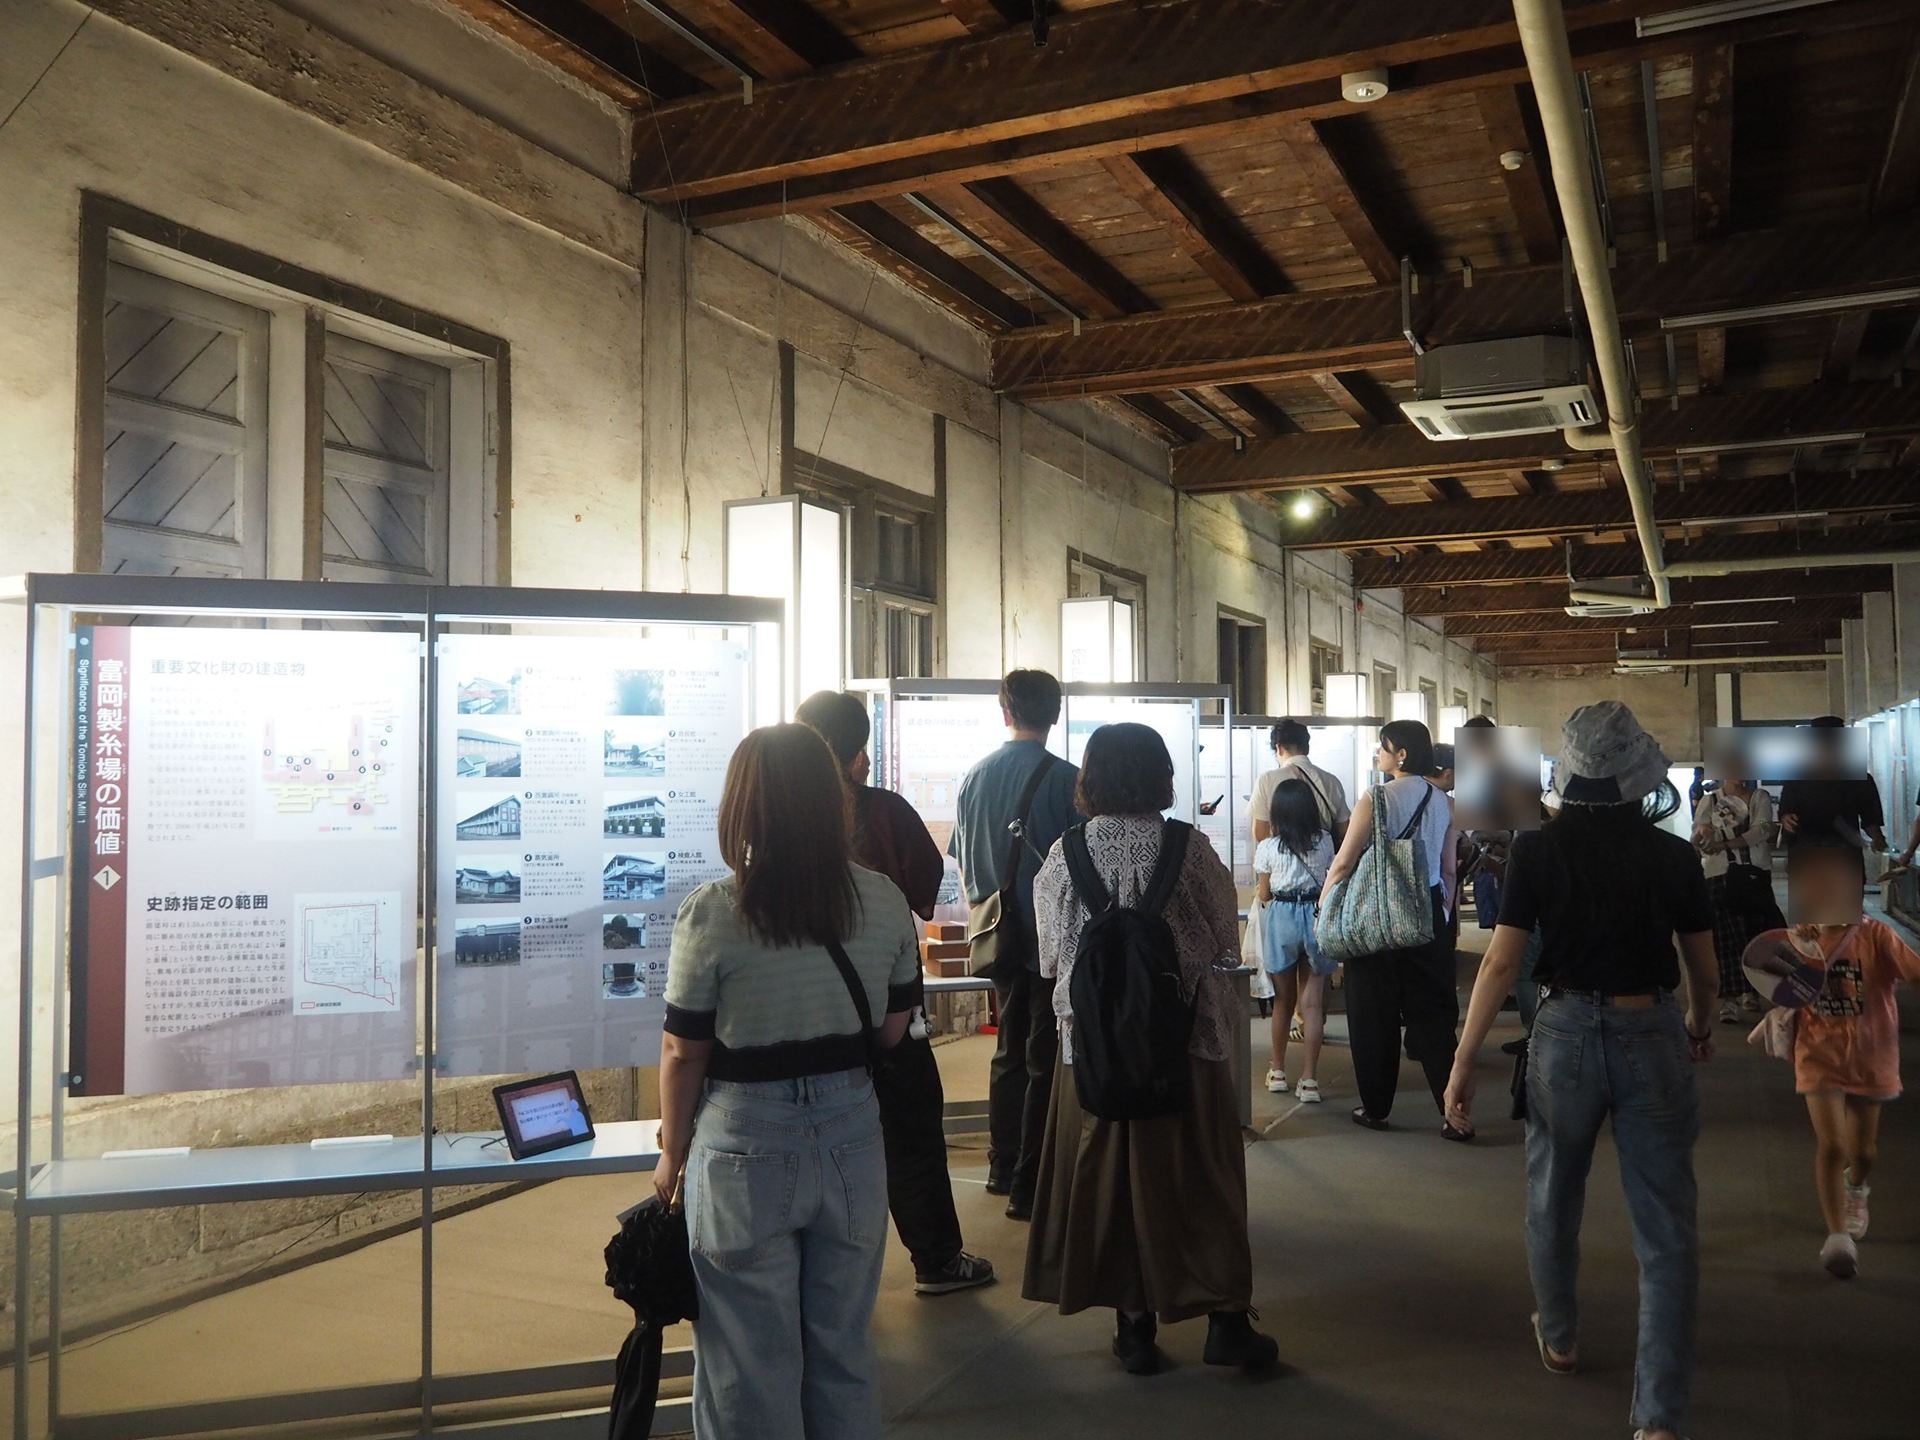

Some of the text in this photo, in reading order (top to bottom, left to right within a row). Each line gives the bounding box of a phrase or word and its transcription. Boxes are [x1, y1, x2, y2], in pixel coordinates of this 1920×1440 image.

[151, 658, 306, 677] 重要文化財の建造物
[78, 659, 90, 712] Significance
[79, 714, 89, 723] of
[78, 726, 88, 740] the
[78, 742, 88, 780] Tomioka
[95, 659, 123, 854] 富岡製糸場の価値
[77, 782, 88, 798] Silk
[77, 801, 87, 816] Mill
[146, 894, 269, 912] 史跡指定の範囲
